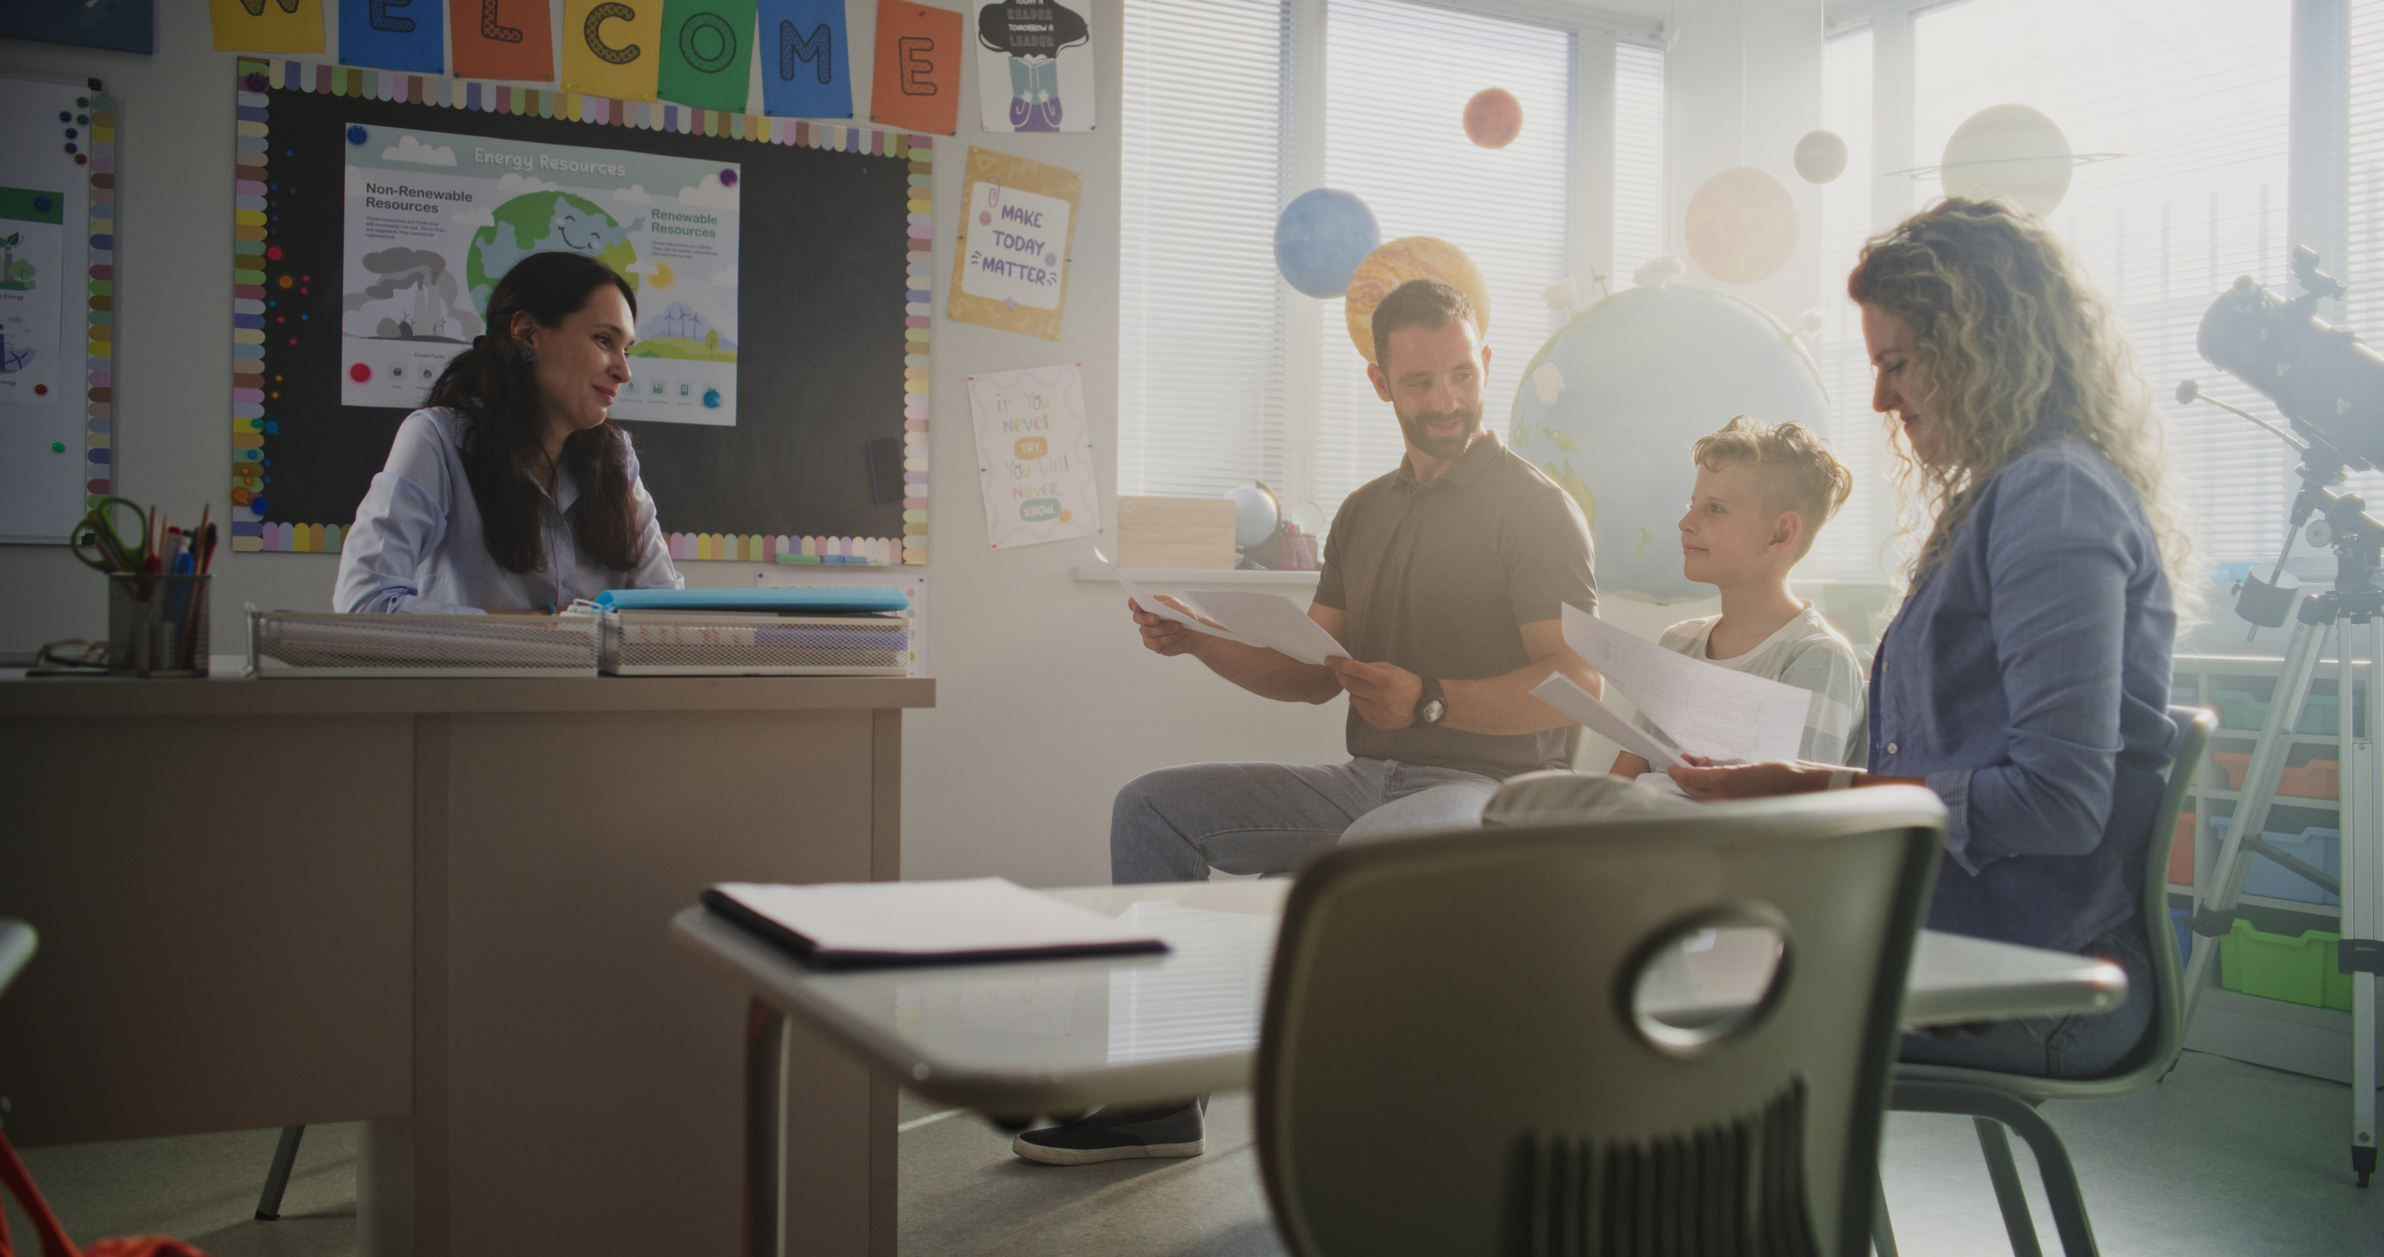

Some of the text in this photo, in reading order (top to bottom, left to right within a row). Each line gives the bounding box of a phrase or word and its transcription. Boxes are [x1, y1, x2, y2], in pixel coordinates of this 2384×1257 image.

[1007, 8, 1053, 20] READER
[1008, 23, 1054, 32] TOMORROW A
[1010, 34, 1054, 47] LEADER
[474, 148, 626, 177] Energy Resources
[366, 182, 473, 203] Non-Renewable
[366, 197, 438, 213] Resources
[651, 208, 718, 225] Renewable
[1002, 204, 1043, 228] MAKE
[651, 222, 716, 238] Resources
[992, 230, 1045, 256] TODAY
[983, 256, 1046, 286] MATTER
